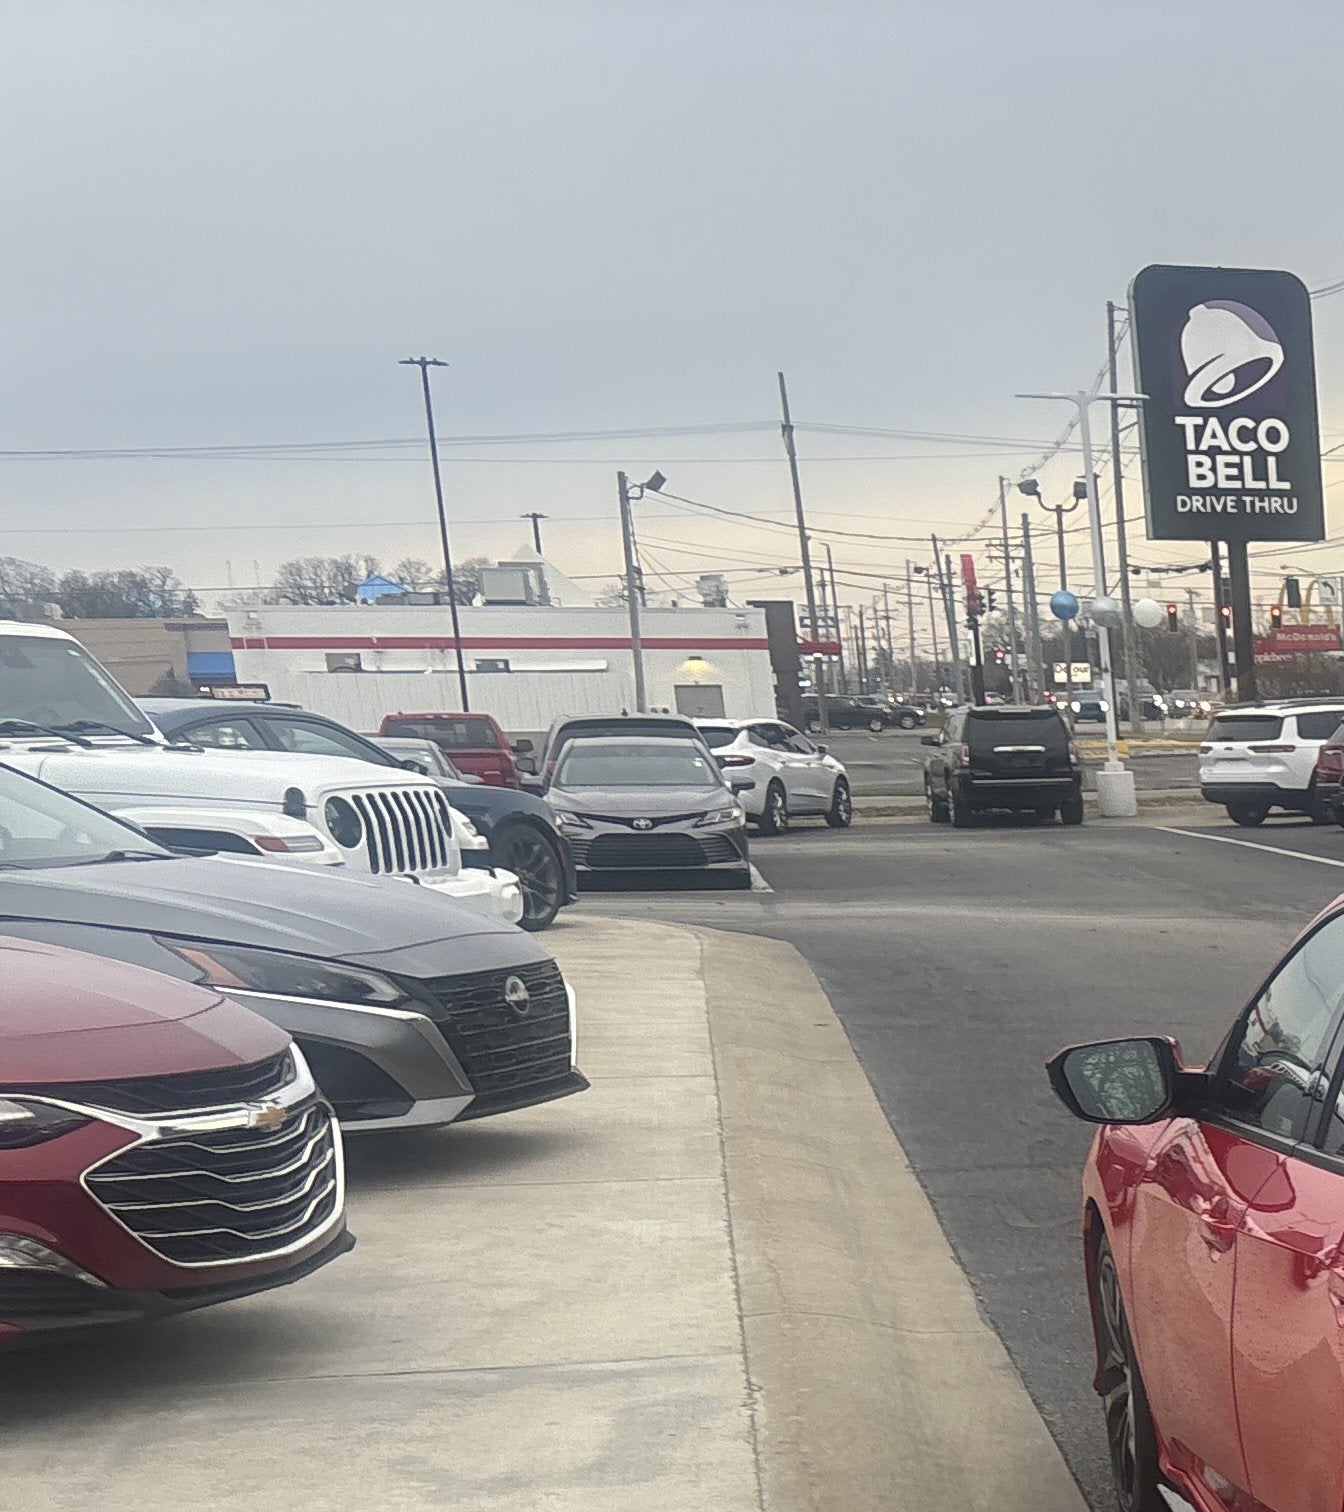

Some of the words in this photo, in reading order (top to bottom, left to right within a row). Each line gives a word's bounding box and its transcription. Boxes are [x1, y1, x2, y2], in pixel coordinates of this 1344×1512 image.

[1175, 416, 1290, 453] TACO
[1187, 454, 1292, 490] BELL
[1176, 496, 1238, 514] DRIVE
[1242, 497, 1298, 515] THRU
